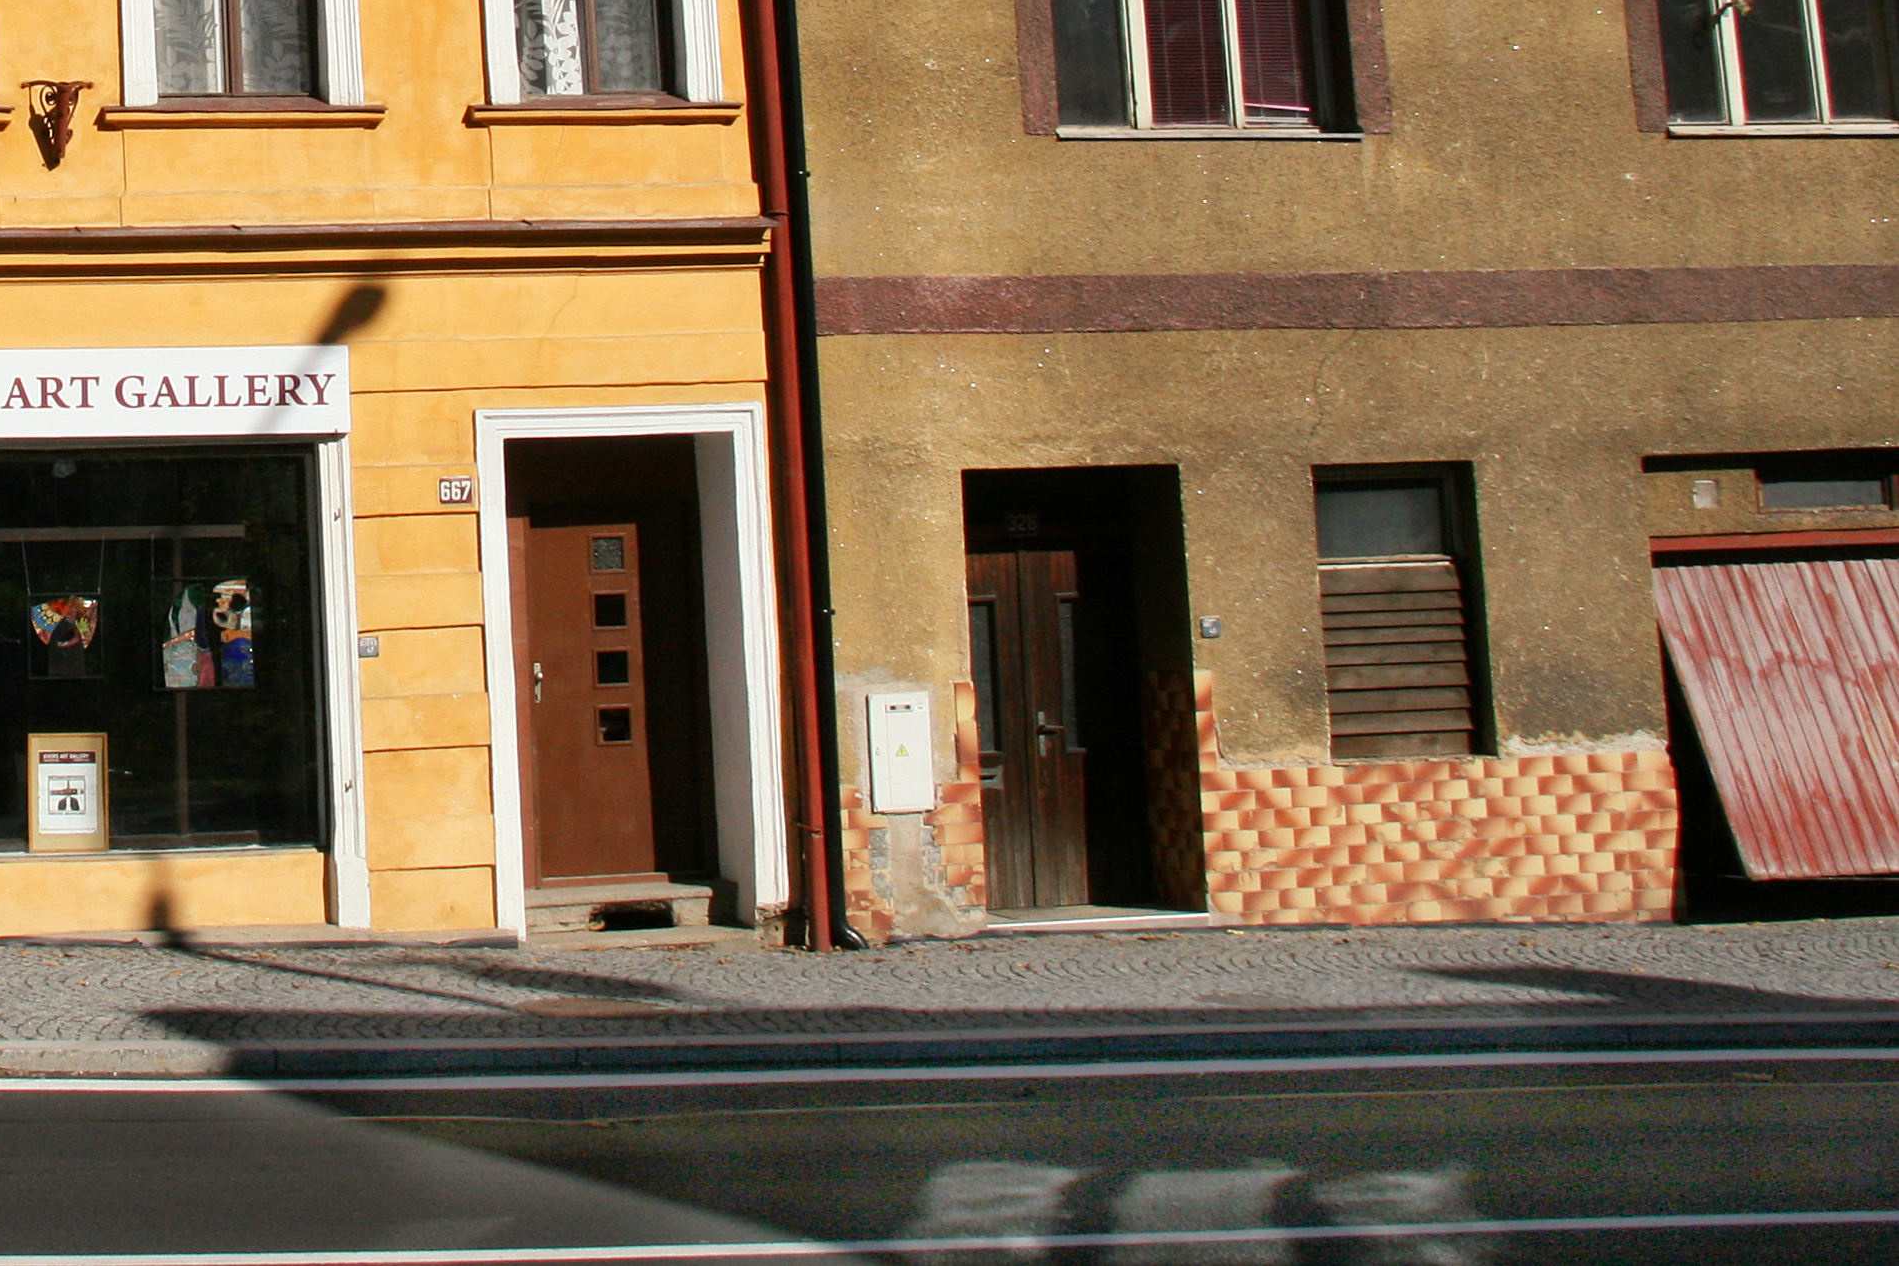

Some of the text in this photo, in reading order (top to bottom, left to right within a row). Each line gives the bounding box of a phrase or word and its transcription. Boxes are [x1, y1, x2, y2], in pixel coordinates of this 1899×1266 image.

[1, 376, 100, 409] ART
[114, 373, 336, 408] GALLERY
[440, 481, 471, 501] 667
